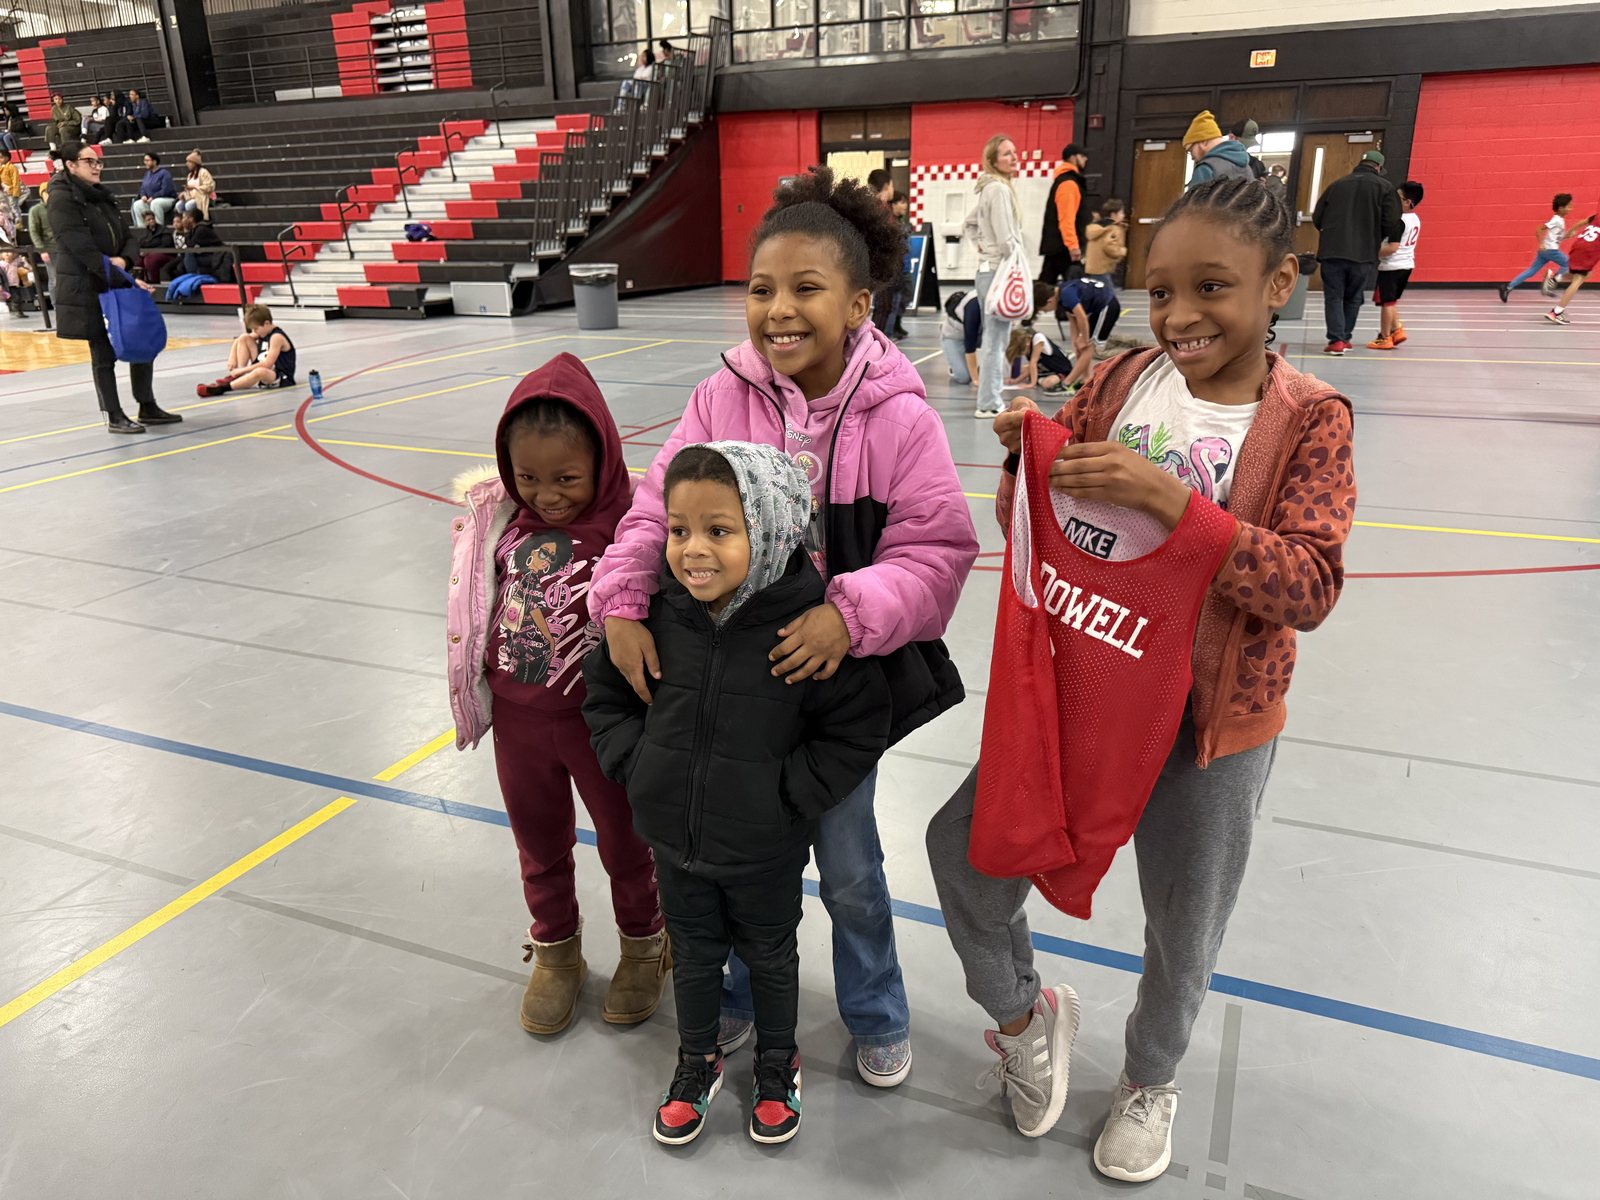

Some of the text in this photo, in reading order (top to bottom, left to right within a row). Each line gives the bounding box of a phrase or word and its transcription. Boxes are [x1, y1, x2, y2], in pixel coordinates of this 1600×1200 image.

[1404, 226, 1419, 247] 12
[1065, 519, 1116, 557] MKE
[1040, 561, 1149, 660] DOWELL
